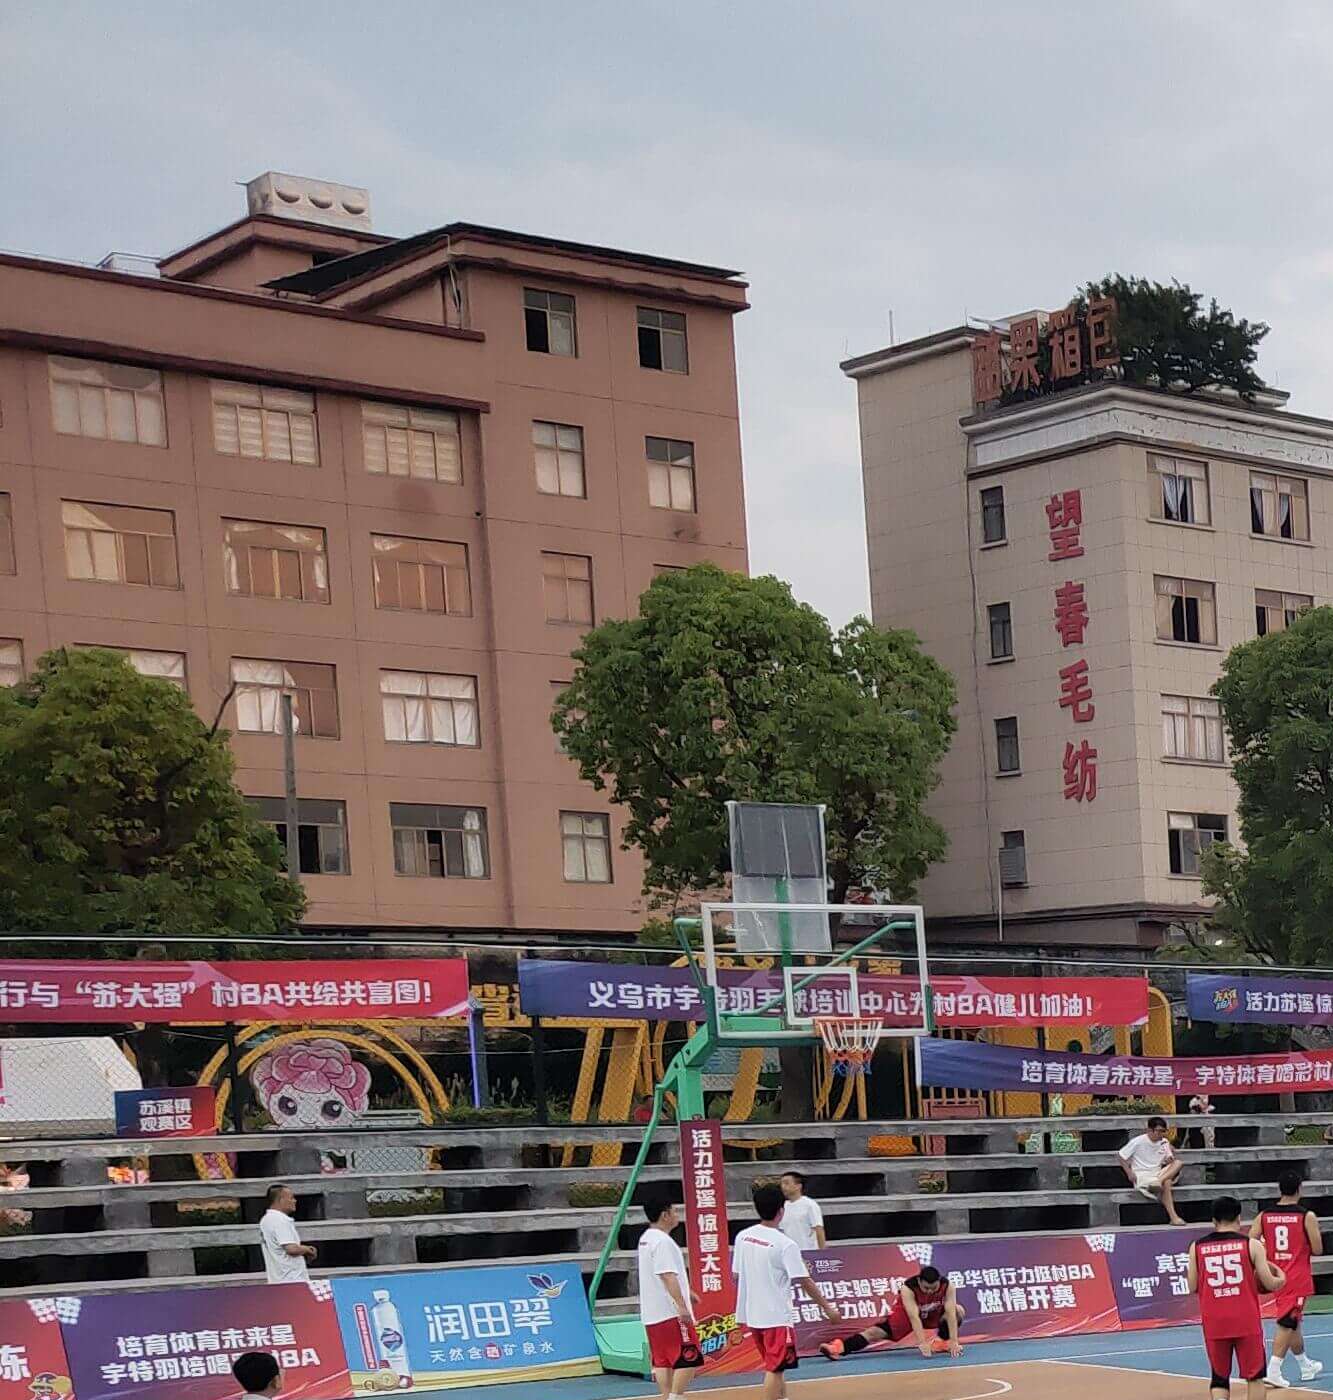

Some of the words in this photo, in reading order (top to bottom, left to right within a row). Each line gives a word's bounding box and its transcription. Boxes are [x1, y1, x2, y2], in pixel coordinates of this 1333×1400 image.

[1045, 488, 1098, 803] 望春毛纺
[1245, 991, 1313, 1014] 活力苏溪
[139, 1098, 192, 1116] 苏溪镇
[691, 1129, 717, 1209] 活力苏溪
[697, 1213, 723, 1293] 惊喜大陈
[1275, 1225, 1288, 1250] 8
[1205, 1252, 1244, 1288] 55
[790, 1277, 907, 1301] 正阳实验学校
[976, 1285, 1077, 1315] 燃情开赛
[423, 1298, 554, 1344] 润田翠
[116, 1323, 297, 1359] 培育体育未来星
[100, 1347, 321, 1385] 宇特羽培喝BA
